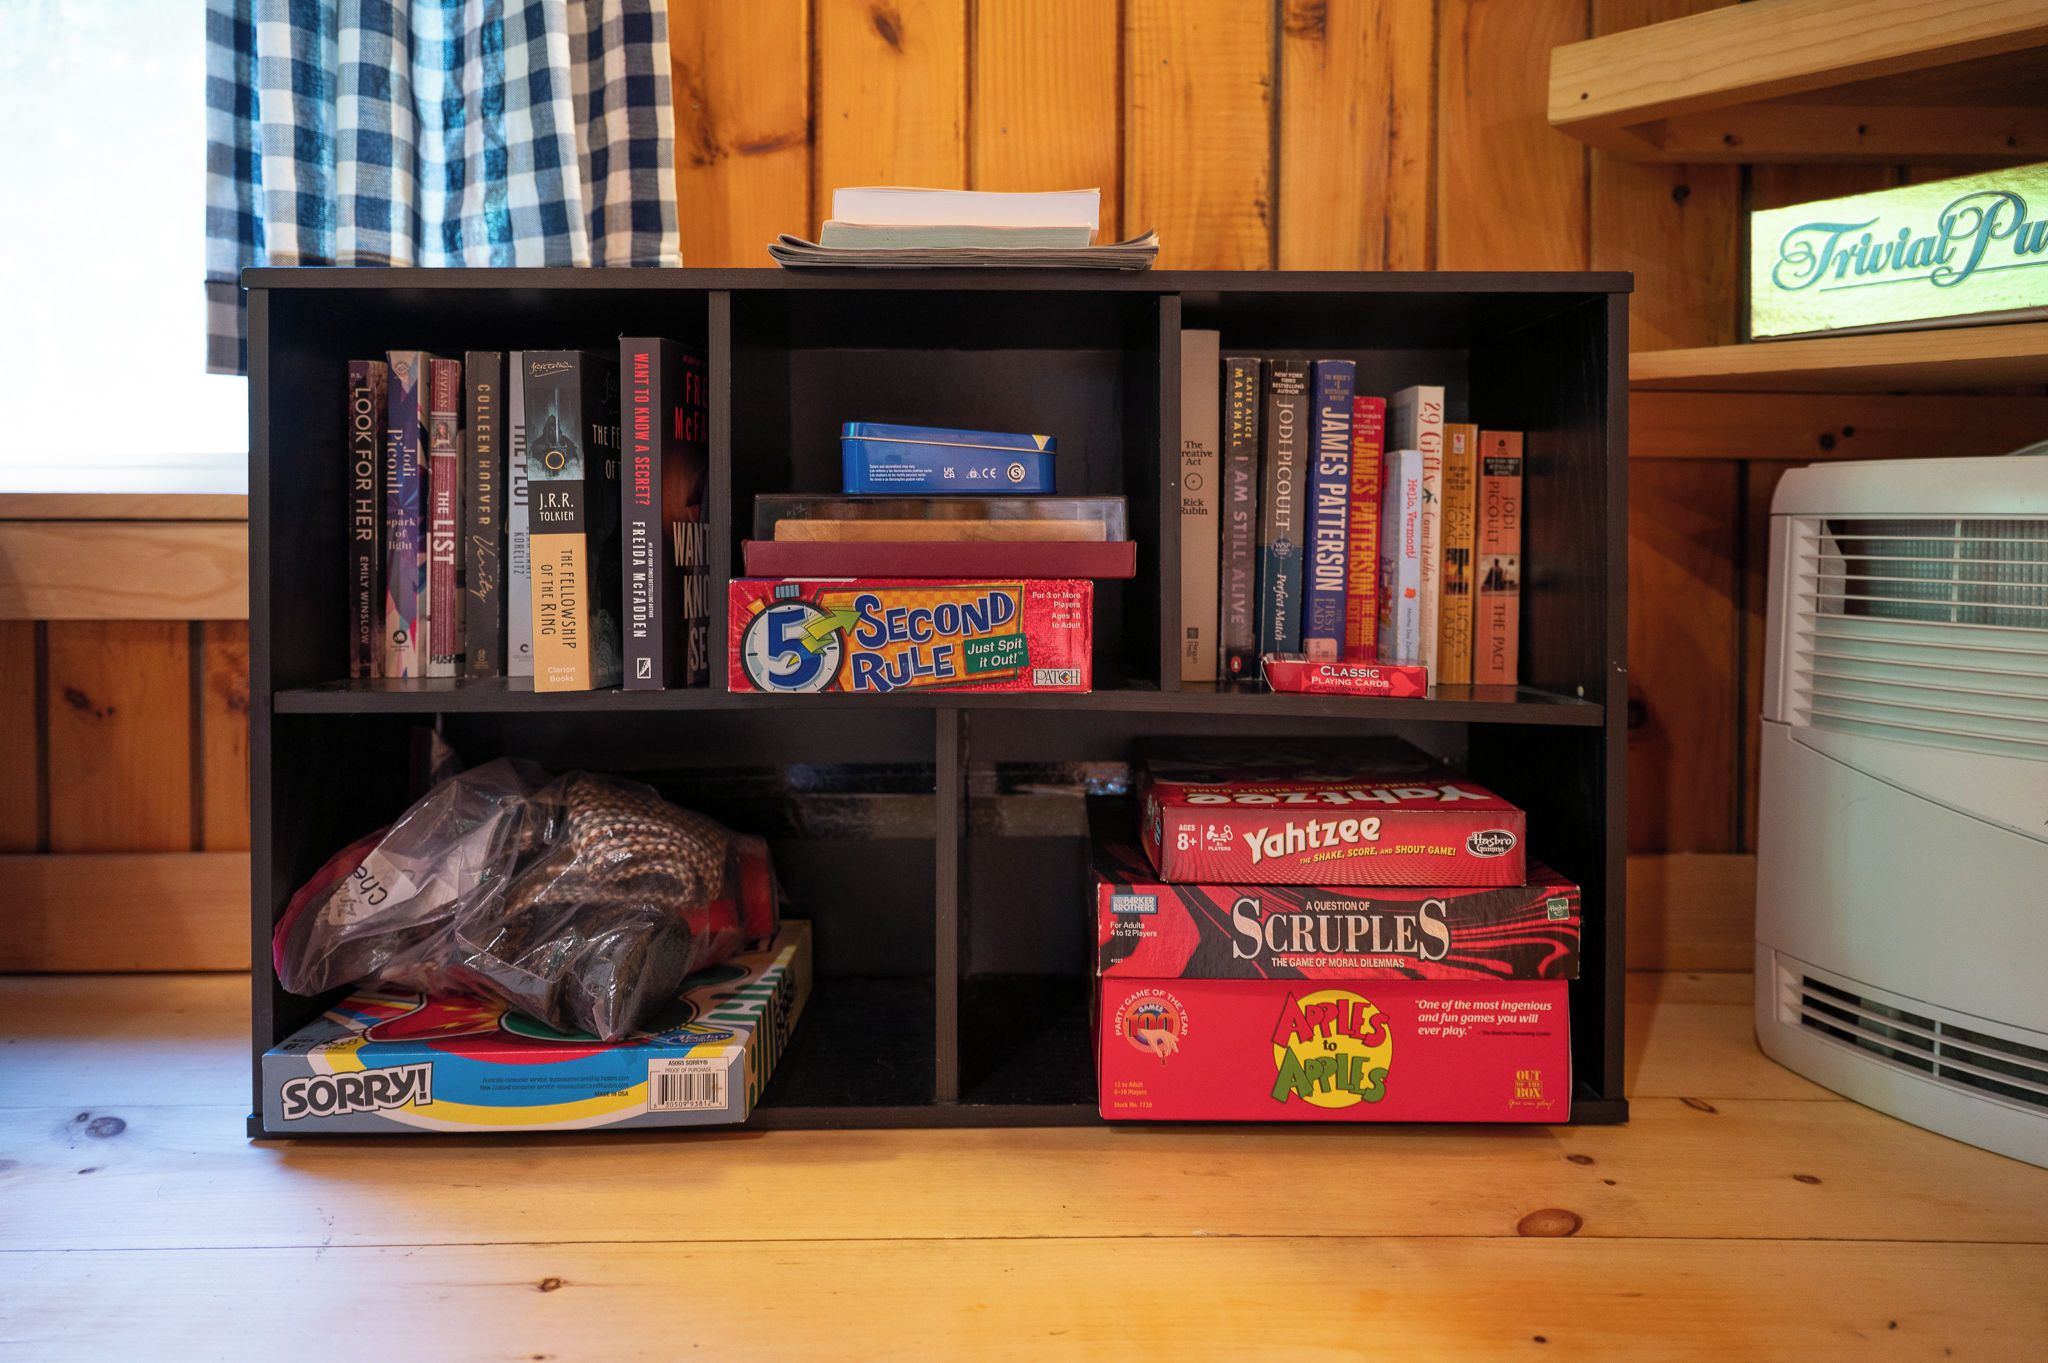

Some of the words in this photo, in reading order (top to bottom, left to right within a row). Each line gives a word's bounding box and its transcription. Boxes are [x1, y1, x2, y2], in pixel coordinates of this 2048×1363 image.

[1772, 215, 1958, 292] Trivial
[634, 353, 649, 385] WANT
[439, 369, 449, 408] VIVIAN
[634, 387, 649, 403] TO
[1245, 377, 1253, 402] KATE
[355, 388, 372, 443] LOOK
[477, 384, 491, 453] COLLEEN
[1232, 367, 1244, 447] MARSHALL
[1244, 408, 1252, 438] ALICE
[1277, 401, 1294, 444] JODI
[1420, 402, 1441, 424] 29
[592, 424, 608, 446] THE
[635, 407, 650, 441] KNOW
[635, 445, 650, 453] A
[1184, 441, 1203, 449] The
[1321, 407, 1350, 476] JAMES
[355, 450, 372, 490] FOR
[387, 429, 403, 494] Picoult
[403, 446, 416, 476] Jodi
[1185, 458, 1202, 466] Act
[1351, 436, 1380, 495] JAMES
[479, 460, 491, 525] HOOVER
[635, 456, 651, 505] SECRET?
[1234, 471, 1249, 501] AM
[1275, 451, 1293, 531] PICOULT
[1407, 479, 1418, 509] Hello,
[438, 491, 450, 514] THE
[539, 493, 574, 510] J.R.R.
[540, 511, 574, 522] TOLKIEN
[1180, 507, 1208, 515] Rubin
[1487, 481, 1500, 543] PICOULT
[1503, 497, 1515, 530] JODI
[356, 499, 372, 540] HER
[395, 530, 407, 538] of
[1232, 511, 1248, 560] STILL
[1406, 511, 1418, 559] Vermont!
[1458, 503, 1471, 541] TAMI
[388, 541, 413, 552] light
[433, 520, 455, 565] LIST
[513, 531, 525, 574] KORELITZ
[632, 522, 646, 566] FREIDA
[673, 522, 709, 567] WANT
[1315, 483, 1348, 592] PATTERSON
[1346, 501, 1378, 596] PATTERSON
[360, 556, 369, 588] EMILY
[470, 535, 496, 604] Verity
[541, 564, 553, 576] OF
[561, 550, 572, 566] THE
[541, 583, 553, 598] THE
[633, 573, 647, 638] McFADDEN
[1054, 601, 1081, 609] Players
[1231, 568, 1248, 624] ALIVE
[1273, 574, 1287, 606] Perfect
[360, 591, 369, 645] WINSLOW
[541, 603, 557, 635] RING
[560, 572, 577, 649] FELLOWSHIP
[852, 591, 1017, 648] SECOND
[1051, 613, 1070, 621] Ages
[1274, 608, 1287, 641] Match
[1314, 598, 1326, 633] LADY
[1324, 597, 1336, 633] FIRST
[1493, 604, 1506, 631] THE
[1442, 608, 1455, 647] LADY
[768, 607, 823, 689] 5
[967, 641, 995, 658] Just
[998, 637, 1024, 658] Spit
[978, 656, 988, 668] it
[990, 652, 1018, 667] Out!
[1492, 637, 1505, 672] PACT
[547, 666, 576, 674] Clarion
[549, 674, 574, 682] Books
[852, 646, 956, 692] RULE
[1034, 669, 1079, 685] PATCH
[1311, 676, 1352, 686] PLAYING
[1354, 679, 1390, 688] CARDS
[1320, 666, 1380, 678] CLASSIC
[1186, 785, 1493, 804] Yahtzee
[1176, 832, 1198, 851] 8+
[1243, 817, 1381, 865] Yahtzee
[1473, 830, 1514, 846] Hasbro
[1476, 844, 1505, 853] Gaming
[1313, 851, 1345, 864] SHAKE,
[1347, 847, 1378, 858] SCORE,
[1395, 845, 1426, 854] SHOUT
[1427, 846, 1456, 856] GAME!
[1113, 903, 1155, 912] BROTHERS
[1123, 896, 1155, 904] PARKER
[1306, 901, 1313, 911] A
[1314, 901, 1358, 912] QUESTION
[1359, 901, 1371, 911] OF
[1123, 921, 1145, 929] Adults
[1132, 930, 1158, 938] Players
[1232, 898, 1450, 960] SCRUPLES
[1271, 957, 1288, 967] THE
[1289, 957, 1314, 967] GAME
[1316, 957, 1327, 967] OF
[1328, 957, 1360, 968] MORAL
[1360, 958, 1405, 968] DILEMMAS
[1114, 1004, 1127, 1036] PARTY
[1124, 988, 1151, 1006] GAME
[1152, 988, 1166, 997] OF
[1166, 993, 1183, 1010] THE
[1179, 1008, 1189, 1036] YEAR
[1138, 1004, 1164, 1014] GAMES
[1272, 991, 1391, 1048] APPLES
[1418, 1013, 1441, 1023] and
[1440, 1013, 1459, 1025] fun
[1460, 1014, 1495, 1026] games
[1497, 1014, 1517, 1026] you
[1519, 1014, 1539, 1024] will
[1441, 1000, 1453, 1012] of
[1454, 1000, 1471, 1010] the
[1473, 1000, 1500, 1010] most
[1501, 1000, 1552, 1013] ingenious
[1322, 1040, 1338, 1051] to
[1418, 1027, 1441, 1035] ever
[1442, 1026, 1473, 1038] play."
[1271, 1045, 1389, 1104] APPLES
[1516, 1070, 1541, 1080] OUT
[283, 1064, 431, 1118] SORRY!
[1516, 1088, 1541, 1098] BOX
